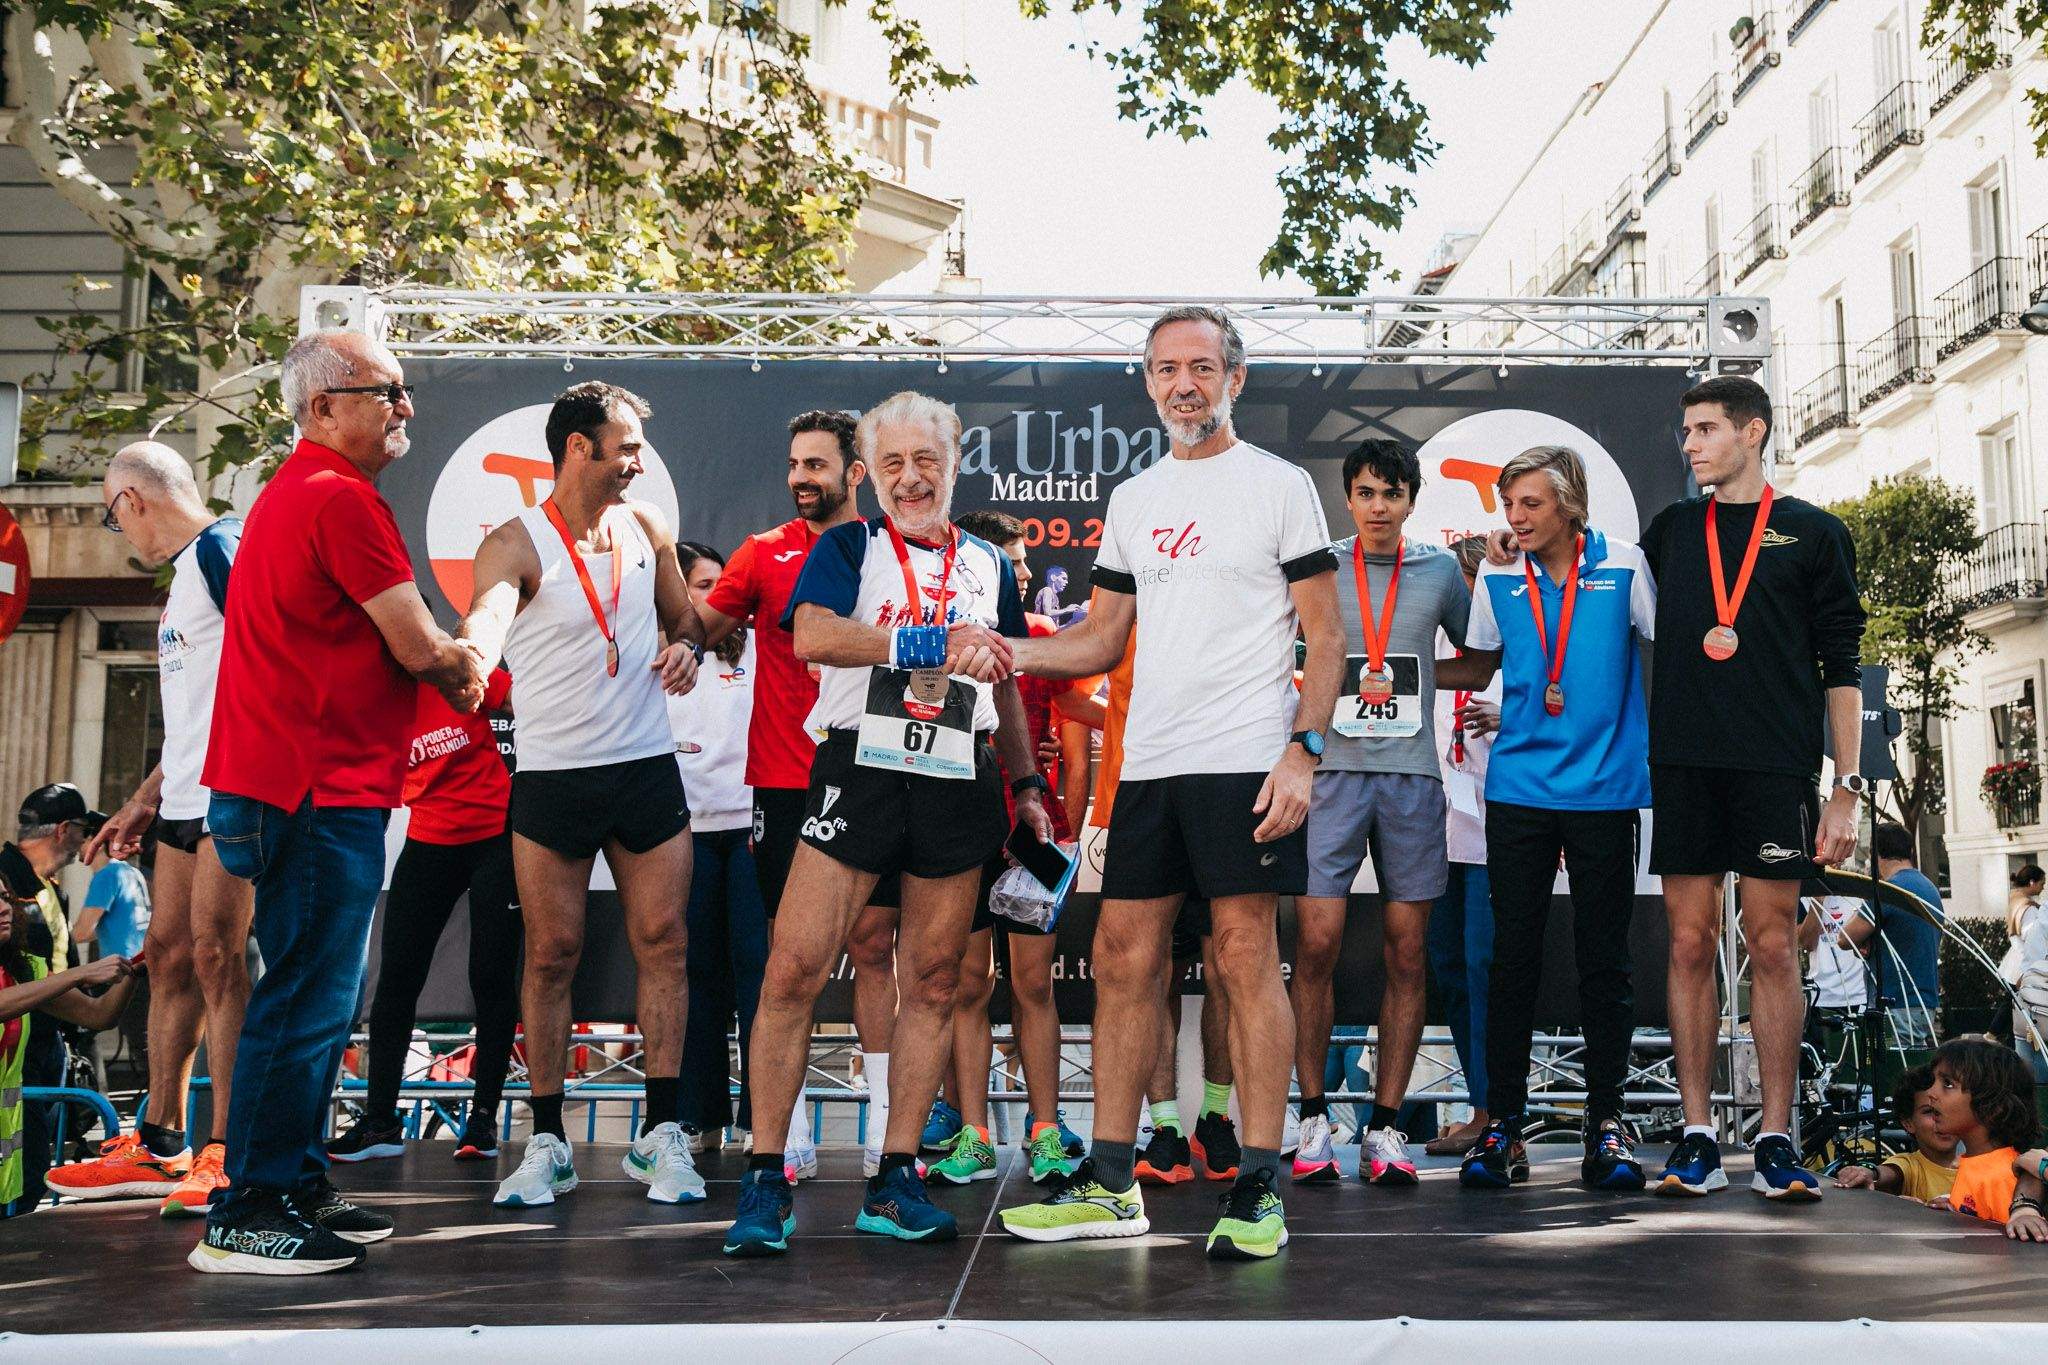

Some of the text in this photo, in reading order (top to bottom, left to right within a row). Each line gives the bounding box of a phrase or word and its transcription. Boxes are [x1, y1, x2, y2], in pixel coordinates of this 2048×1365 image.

[1012, 404, 1171, 477] Urba
[990, 472, 1100, 502] Madrid
[1022, 517, 1104, 548] 09.2
[1136, 563, 1241, 587] afaelhoteles
[1355, 696, 1398, 720] 245
[421, 726, 464, 747] PODER DEL
[426, 733, 471, 759] CHANDAL
[903, 721, 938, 754] 67
[872, 752, 899, 762] MADRID
[801, 816, 836, 841] GO
[209, 1225, 304, 1259] MADRID
